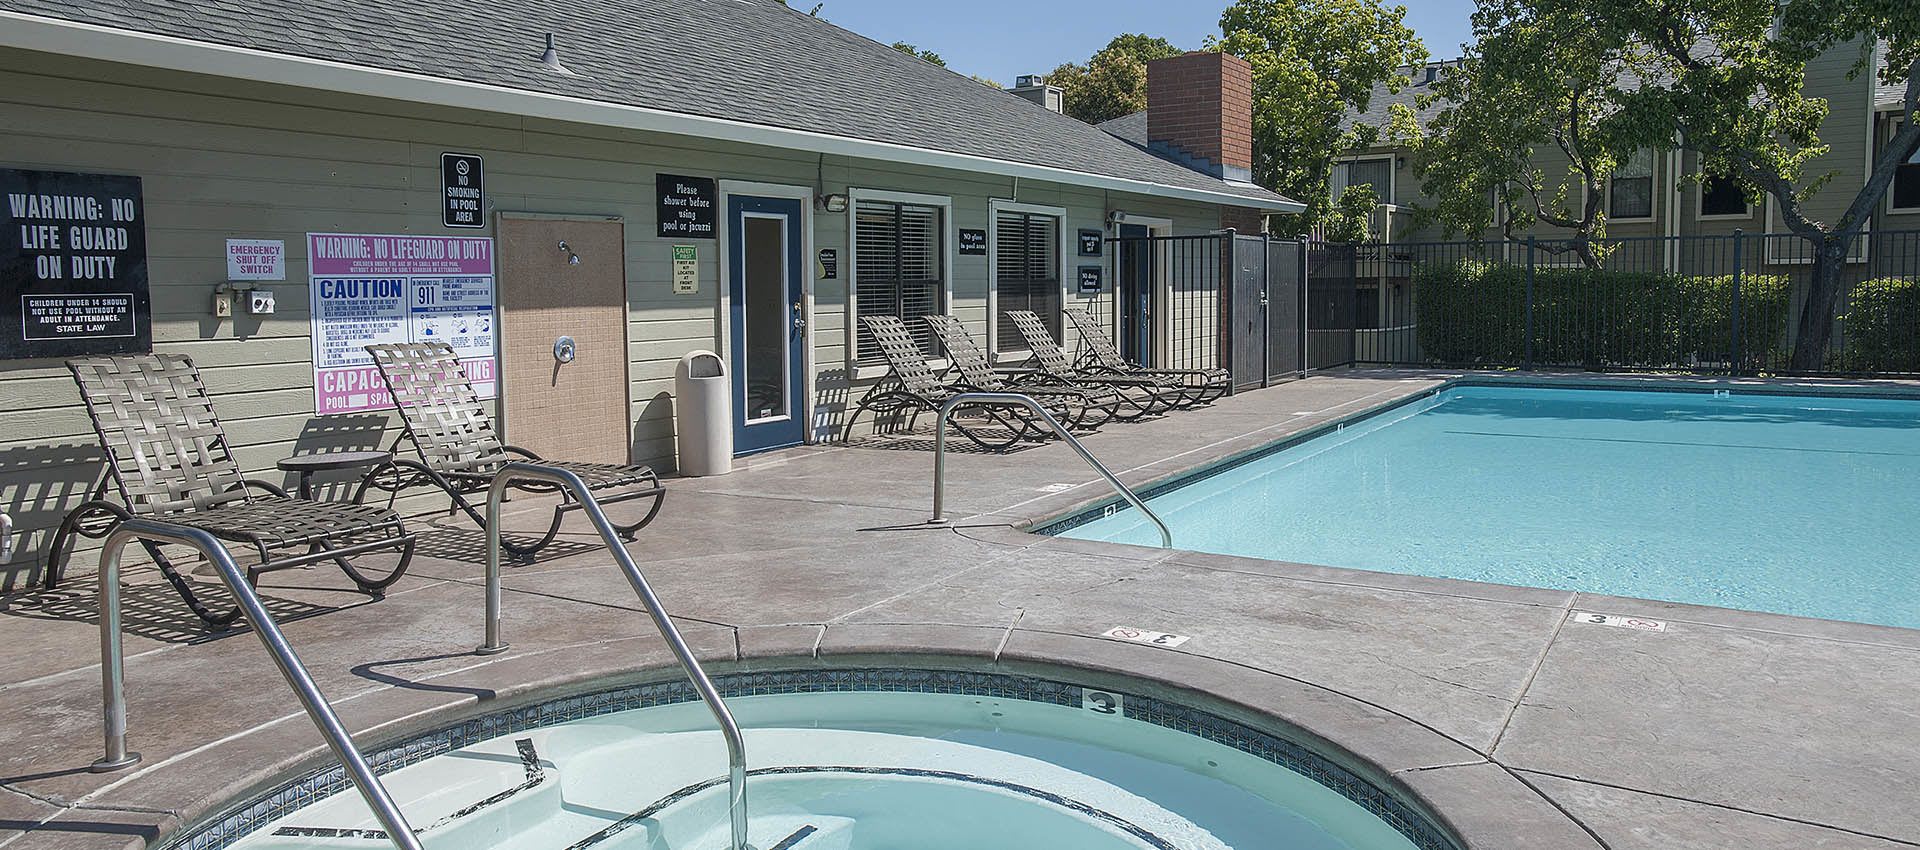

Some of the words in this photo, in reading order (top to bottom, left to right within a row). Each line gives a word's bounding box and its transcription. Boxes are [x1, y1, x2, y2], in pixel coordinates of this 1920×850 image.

[458, 175, 469, 186] NO
[447, 186, 480, 199] SMOKING
[676, 183, 698, 195] Please
[450, 199, 458, 209] IN
[459, 200, 478, 211] POOL
[663, 194, 687, 206] shower
[689, 196, 710, 208] before
[8, 193, 103, 221] WARNING:
[111, 198, 136, 222] NO
[455, 211, 474, 222] AREA
[678, 208, 697, 221] using
[663, 219, 678, 232] pool
[679, 223, 687, 231] or
[21, 224, 61, 249] LIFE
[70, 226, 128, 251] GUARD
[230, 245, 281, 255] EMERGENCY
[316, 236, 371, 259] WARNING:
[373, 238, 389, 259] NO
[391, 239, 445, 260] LIFEGUARD
[447, 240, 461, 260] ON
[463, 241, 488, 261] DUTY
[235, 255, 258, 265] SHUT
[261, 255, 277, 265] OFF
[36, 254, 62, 279] ON
[71, 255, 116, 279] DUTY
[240, 265, 274, 274] SWITCH
[320, 279, 403, 299] CAUTION
[418, 286, 435, 305] 911
[29, 299, 64, 308] CHILDREN
[66, 299, 90, 307] UNDER
[92, 298, 100, 307] 14
[102, 298, 128, 306] SHOULD
[31, 308, 46, 316] NOT
[48, 307, 63, 316] USE
[65, 307, 83, 315] POOL
[85, 306, 114, 315] WITHOUT
[116, 306, 126, 314] AN
[39, 315, 62, 324] ADULT
[64, 315, 72, 323] IN
[74, 314, 121, 323] ATTENDANCE.
[56, 324, 84, 333] STATE
[86, 324, 106, 332] LAW
[326, 395, 349, 410] POOL
[1588, 614, 1607, 624] 3
[1087, 691, 1116, 715] 3
